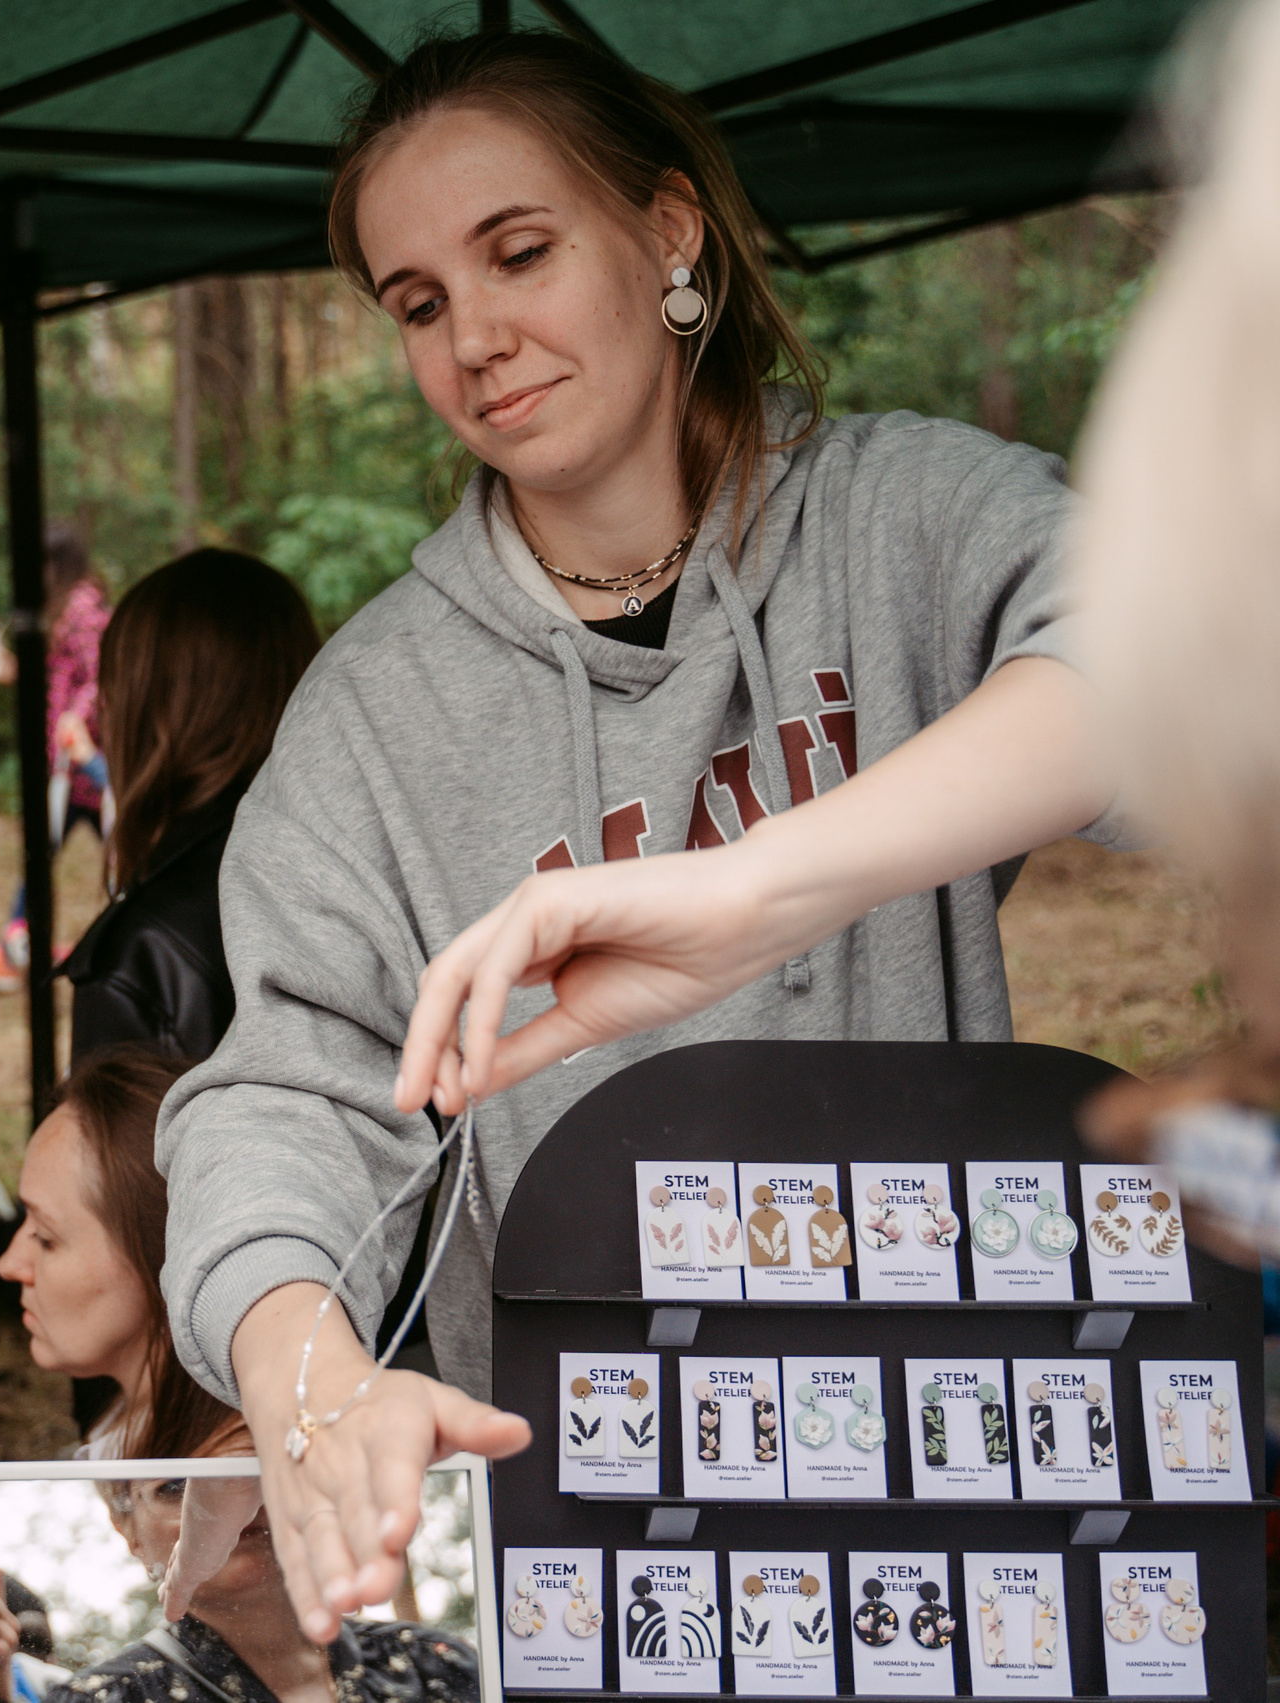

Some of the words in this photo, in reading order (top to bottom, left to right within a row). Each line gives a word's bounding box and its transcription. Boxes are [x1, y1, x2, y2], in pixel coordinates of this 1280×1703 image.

[626, 598, 640, 611] A
[665, 1175, 708, 1187] STEM
[769, 1179, 812, 1191] STEM
[881, 1179, 925, 1191] STEM
[995, 1178, 1039, 1190] STEM
[1108, 1178, 1151, 1190] STEM
[1117, 1195, 1152, 1203] TELIER
[590, 1369, 634, 1381] STEM
[709, 1372, 753, 1384] STEM
[812, 1372, 855, 1384] STEM
[934, 1373, 978, 1385] STEM
[1042, 1374, 1085, 1386] STEM
[1170, 1375, 1212, 1386] STEM
[592, 1386, 630, 1394] ATELIE
[817, 1389, 852, 1397] TELIE
[941, 1390, 979, 1398] TELIER
[1178, 1392, 1212, 1400] TELIER
[533, 1564, 576, 1575] STEM
[646, 1566, 690, 1578] STEM
[760, 1568, 804, 1580] STEM
[878, 1566, 921, 1578] STEM
[993, 1569, 1038, 1581] STEM
[1129, 1567, 1172, 1578] STEM
[536, 1580, 570, 1588] TELIE
[763, 1585, 802, 1593] ATELIE
[1000, 1586, 1035, 1594] TELIE
[1138, 1584, 1165, 1592] ELIE
